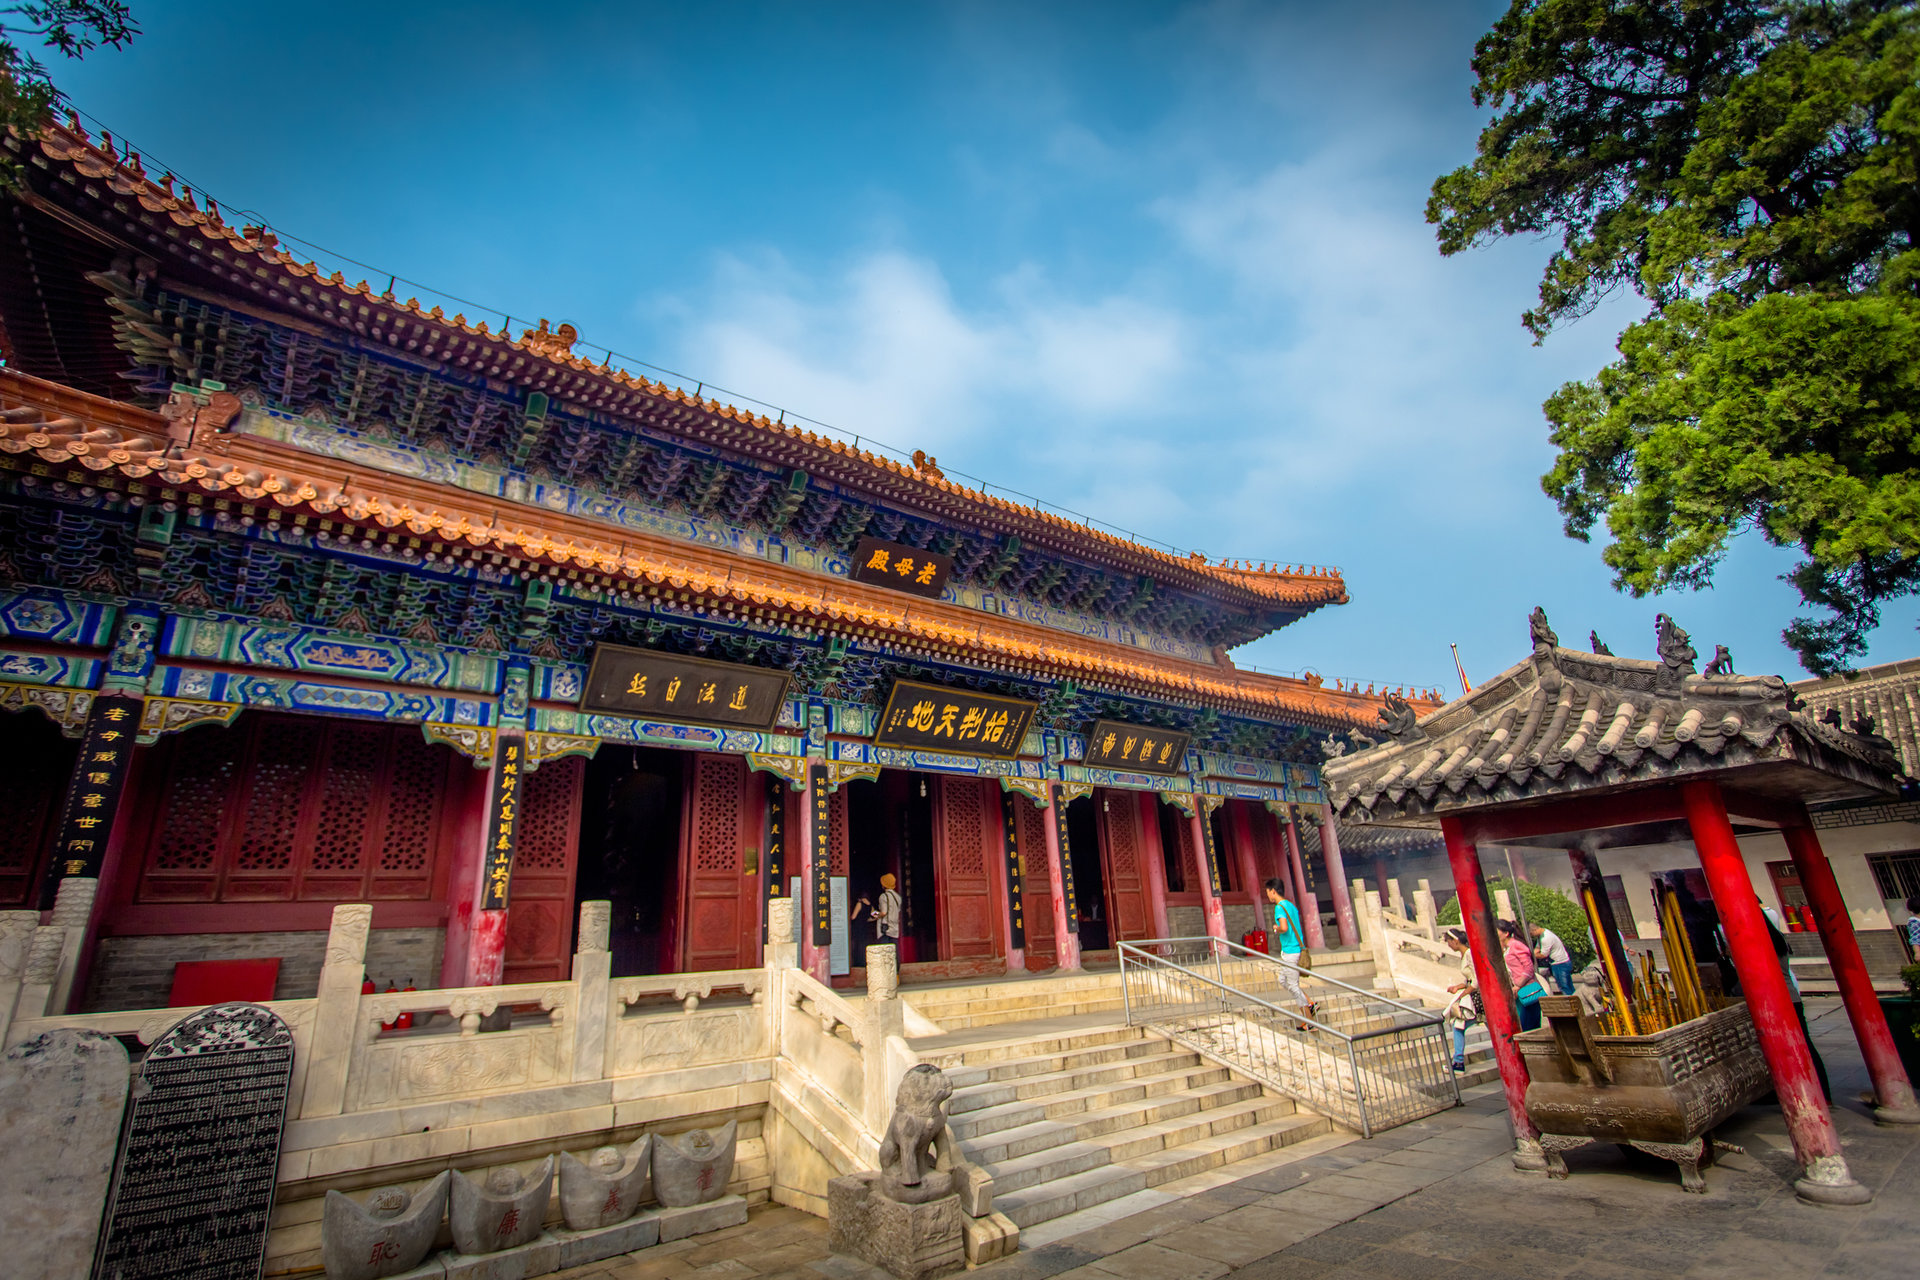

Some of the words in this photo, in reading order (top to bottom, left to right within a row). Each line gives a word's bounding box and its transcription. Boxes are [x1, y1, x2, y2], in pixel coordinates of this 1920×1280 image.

[866, 549, 936, 585] 老母殿
[626, 672, 748, 711] 道法自然
[601, 1188, 621, 1215] 義
[496, 1208, 521, 1236] 廉
